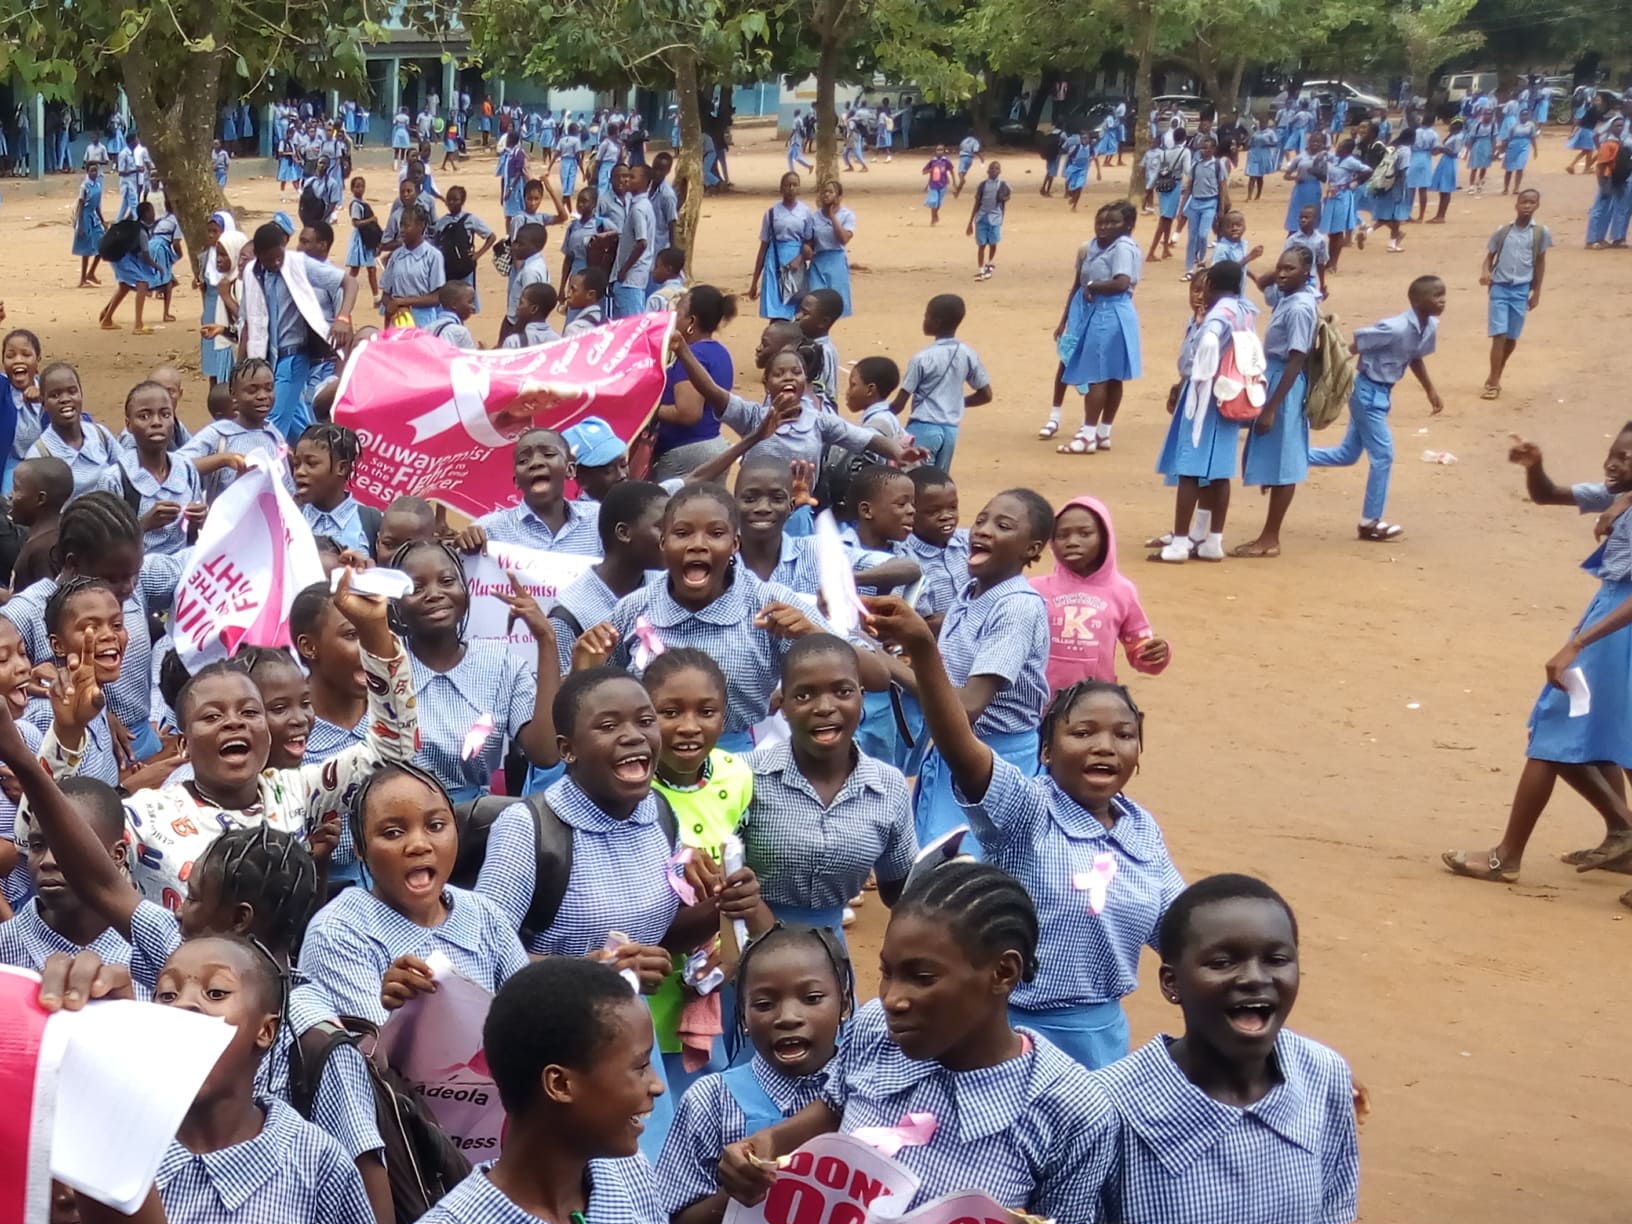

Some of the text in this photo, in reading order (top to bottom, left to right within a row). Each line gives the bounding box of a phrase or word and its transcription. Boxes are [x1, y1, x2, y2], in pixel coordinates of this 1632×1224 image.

[370, 457, 396, 473] Says
[371, 468, 390, 481] the
[188, 570, 217, 605] THE
[1061, 605, 1097, 640] K
[415, 1084, 489, 1107] Adeola
